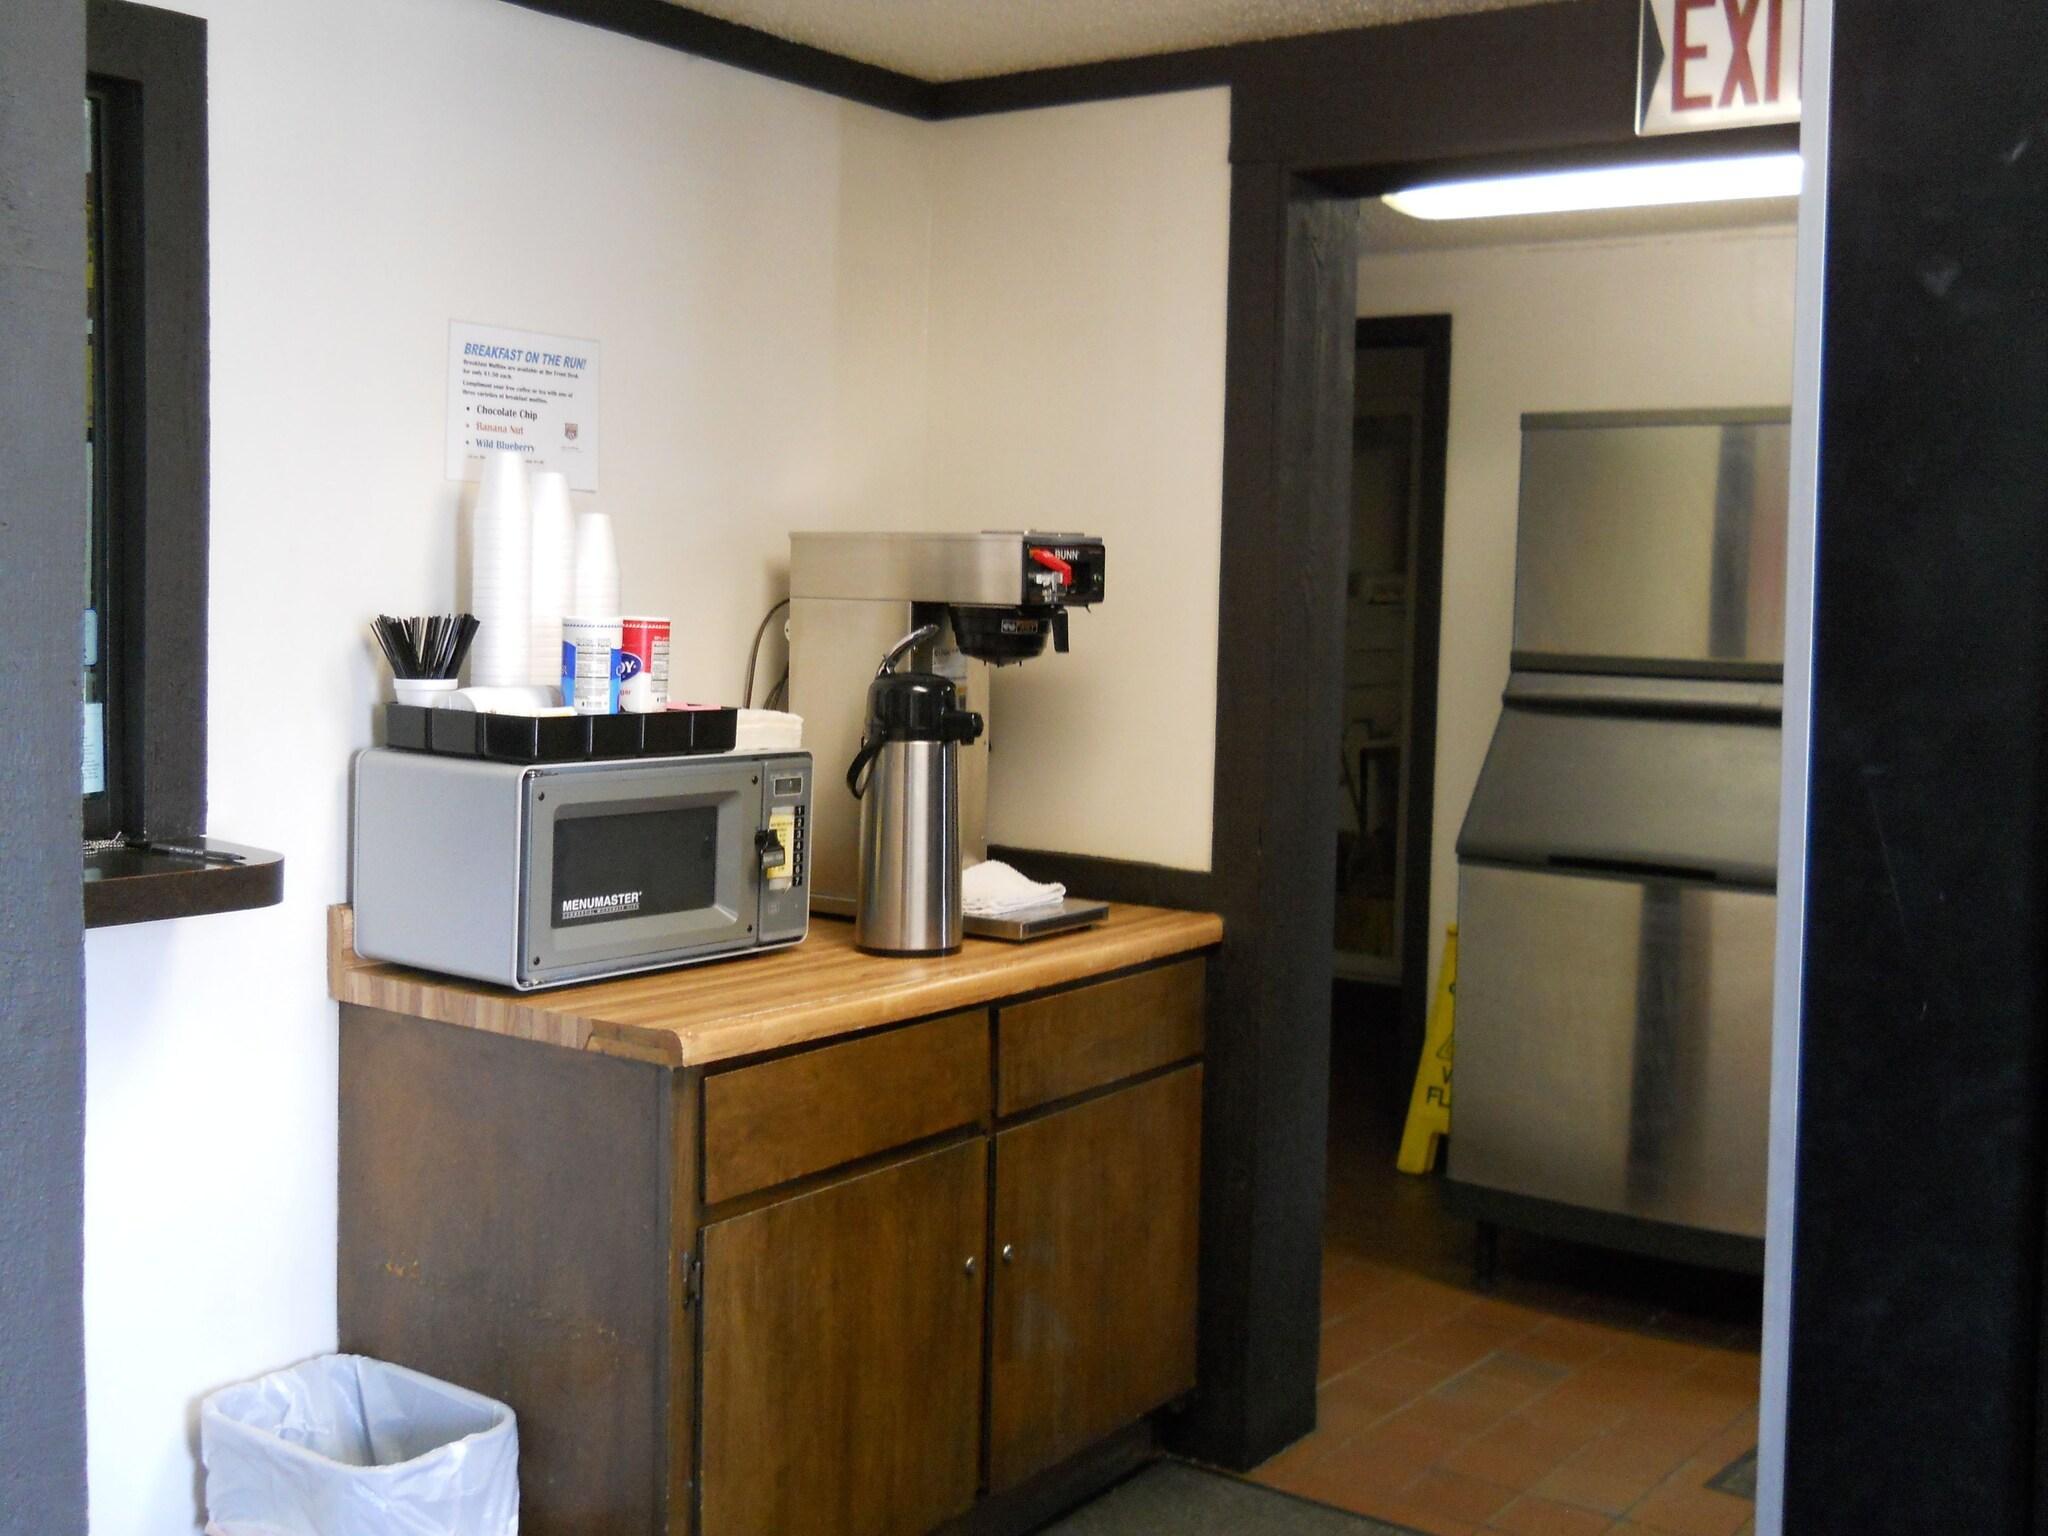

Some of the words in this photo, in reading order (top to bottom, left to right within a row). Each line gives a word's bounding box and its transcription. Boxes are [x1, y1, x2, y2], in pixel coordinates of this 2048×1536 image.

[1671, 0, 1784, 112] EXI
[464, 344, 522, 360] BREAKFAST
[526, 352, 540, 363] ON
[543, 354, 560, 366] THE
[564, 357, 586, 369] RUN!
[477, 406, 517, 418] Chocolate
[520, 410, 538, 421] Chip
[477, 423, 508, 433] Banana
[511, 426, 524, 435] Nut
[477, 440, 494, 449] Wild
[497, 441, 534, 452] Blueberry
[1054, 548, 1078, 560] BUNN
[562, 891, 640, 912] MENUMASTER
